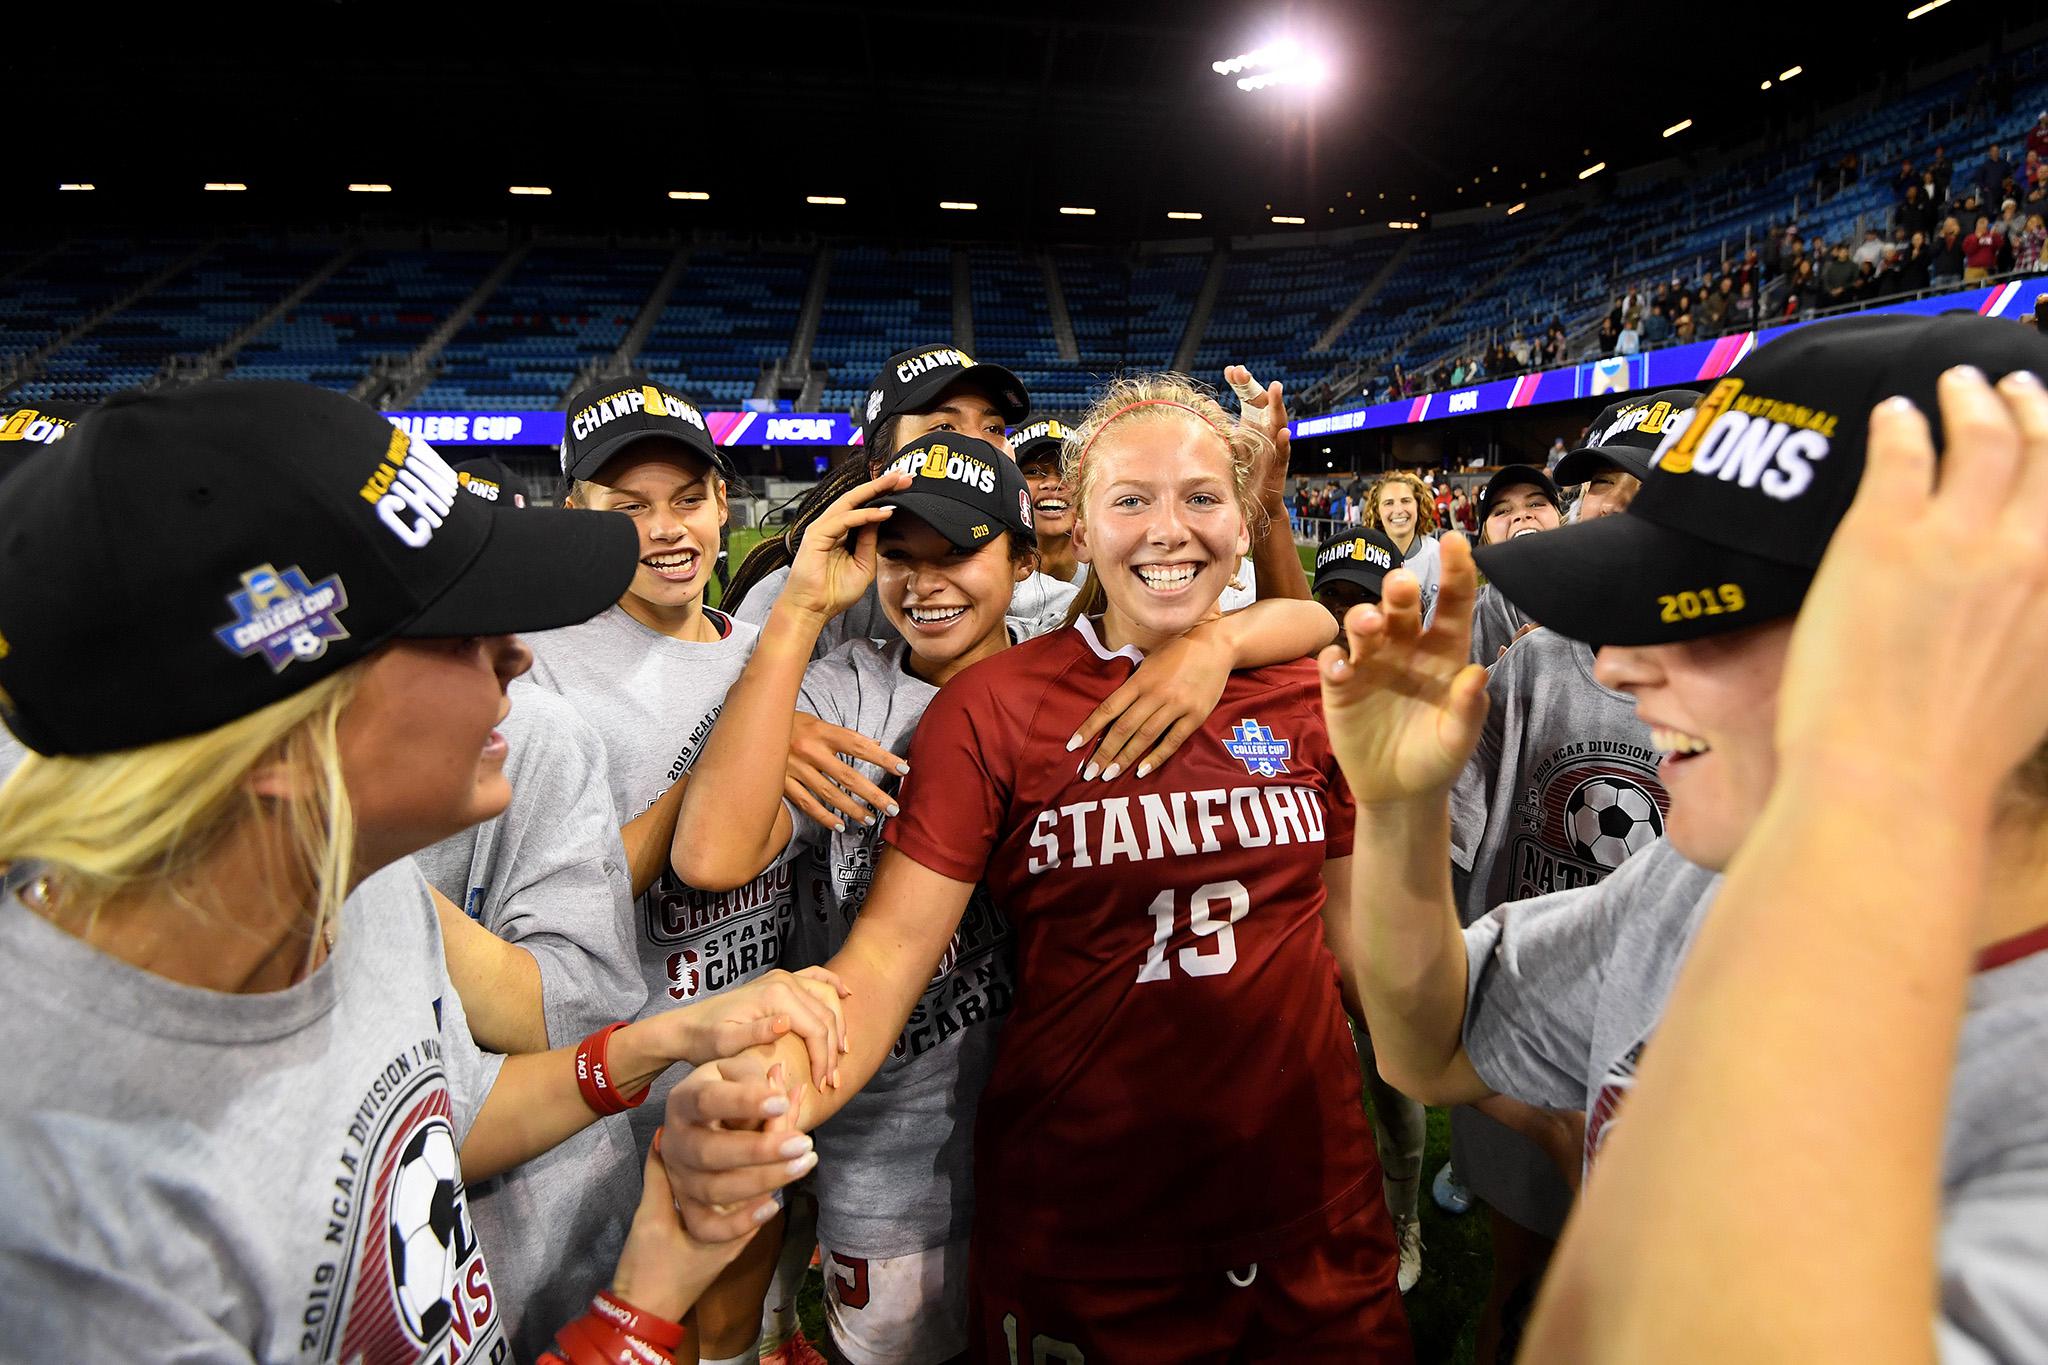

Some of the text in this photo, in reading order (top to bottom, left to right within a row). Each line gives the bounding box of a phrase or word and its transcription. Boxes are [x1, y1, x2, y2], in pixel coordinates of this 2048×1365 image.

[472, 416, 523, 441] CUP
[766, 418, 832, 441] NCAA
[1732, 394, 1838, 437] NATIONAL
[971, 524, 990, 540] 2019
[233, 604, 307, 648] COLLEGE
[301, 586, 336, 616] CUP
[1657, 583, 1746, 624] 2019
[667, 714, 715, 781] 2019 NCAA
[1232, 744, 1285, 755] COLLEGE CUP
[1532, 759, 1552, 784] 2019
[1588, 741, 1654, 763] DIVISION
[1028, 786, 1326, 875] STANFORD
[839, 869, 872, 881] COLLEGE
[1135, 879, 1250, 984] 19
[301, 1261, 336, 1351] 2019
[325, 1151, 358, 1245] NCAA
[347, 1053, 411, 1145] DIVISION
